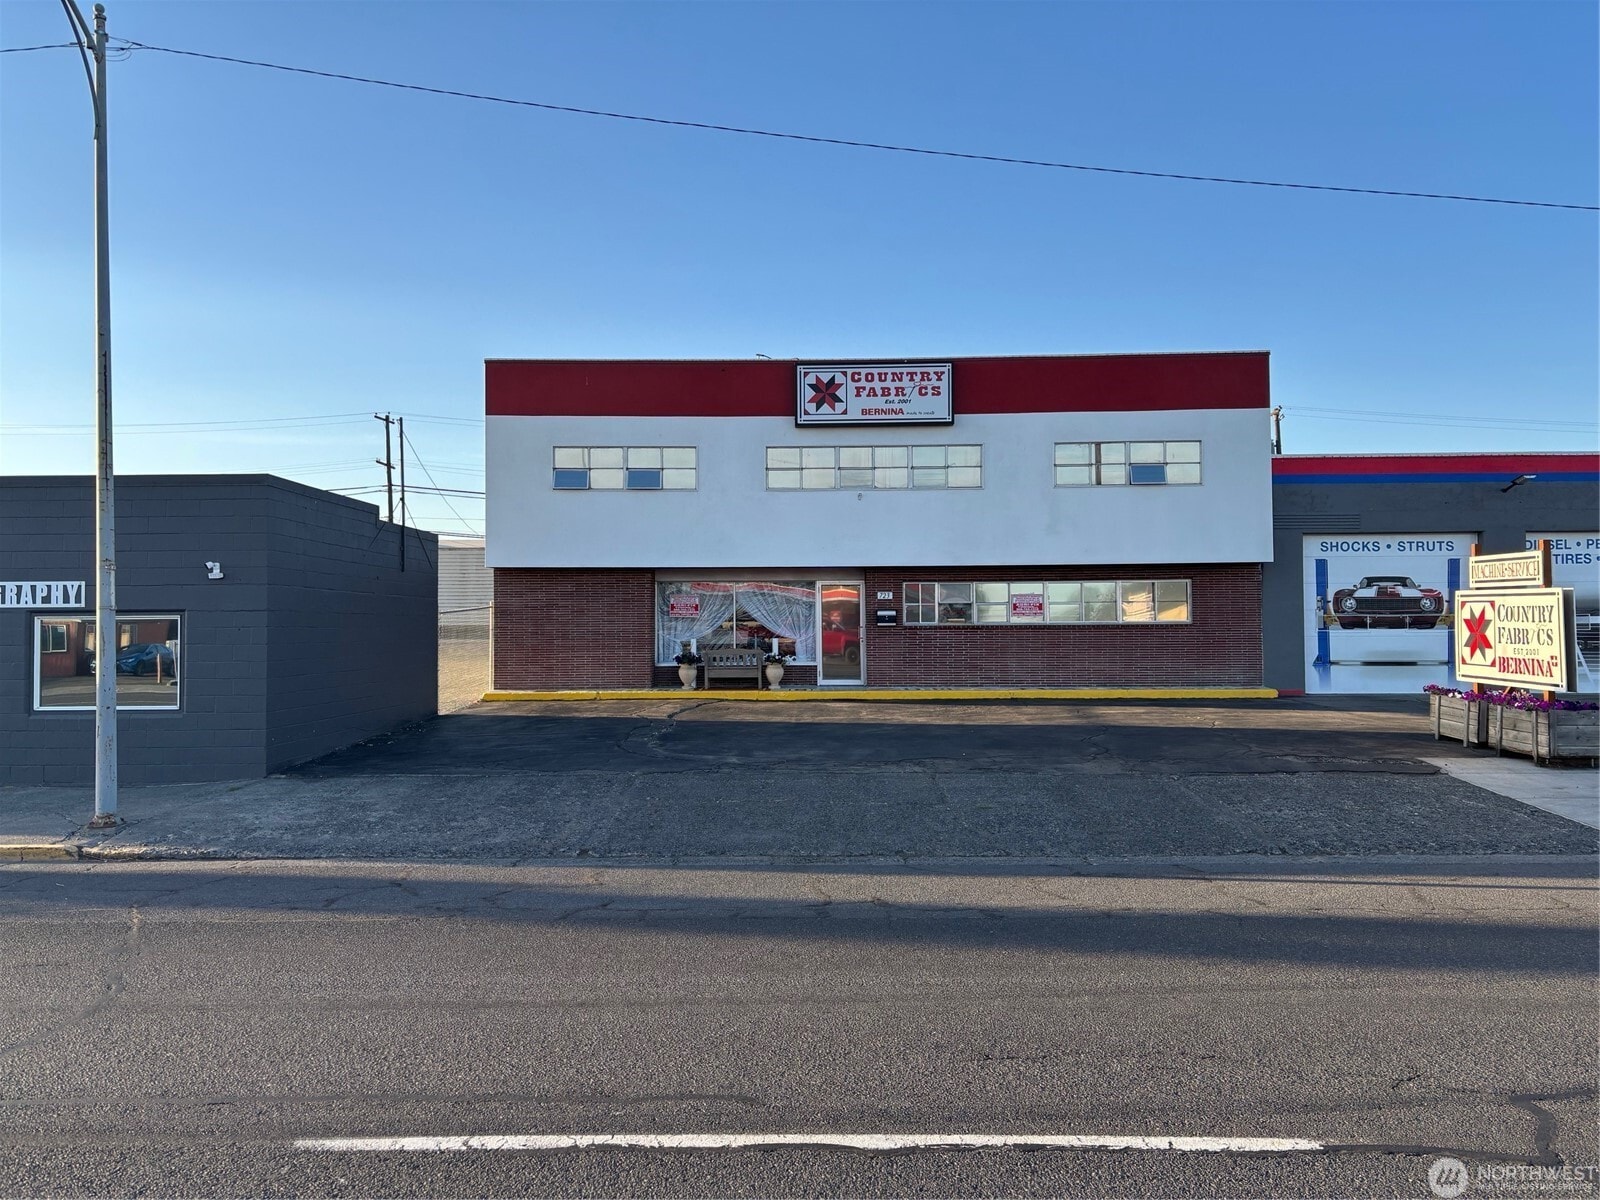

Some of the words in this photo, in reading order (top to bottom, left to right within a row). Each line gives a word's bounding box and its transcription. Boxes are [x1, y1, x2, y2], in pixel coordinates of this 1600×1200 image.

[850, 371, 945, 383] COUNTRY
[861, 408, 904, 416] BERNINA
[1320, 541, 1380, 552] SHOCKS
[1397, 540, 1455, 552] STRUTS
[1525, 539, 1572, 550] DISEL
[1552, 553, 1592, 565] TIRES
[0, 584, 80, 604] RAPHY
[1497, 604, 1554, 623] COUNTRY
[1525, 648, 1540, 656] 2001
[1498, 656, 1554, 678] BERNINA
